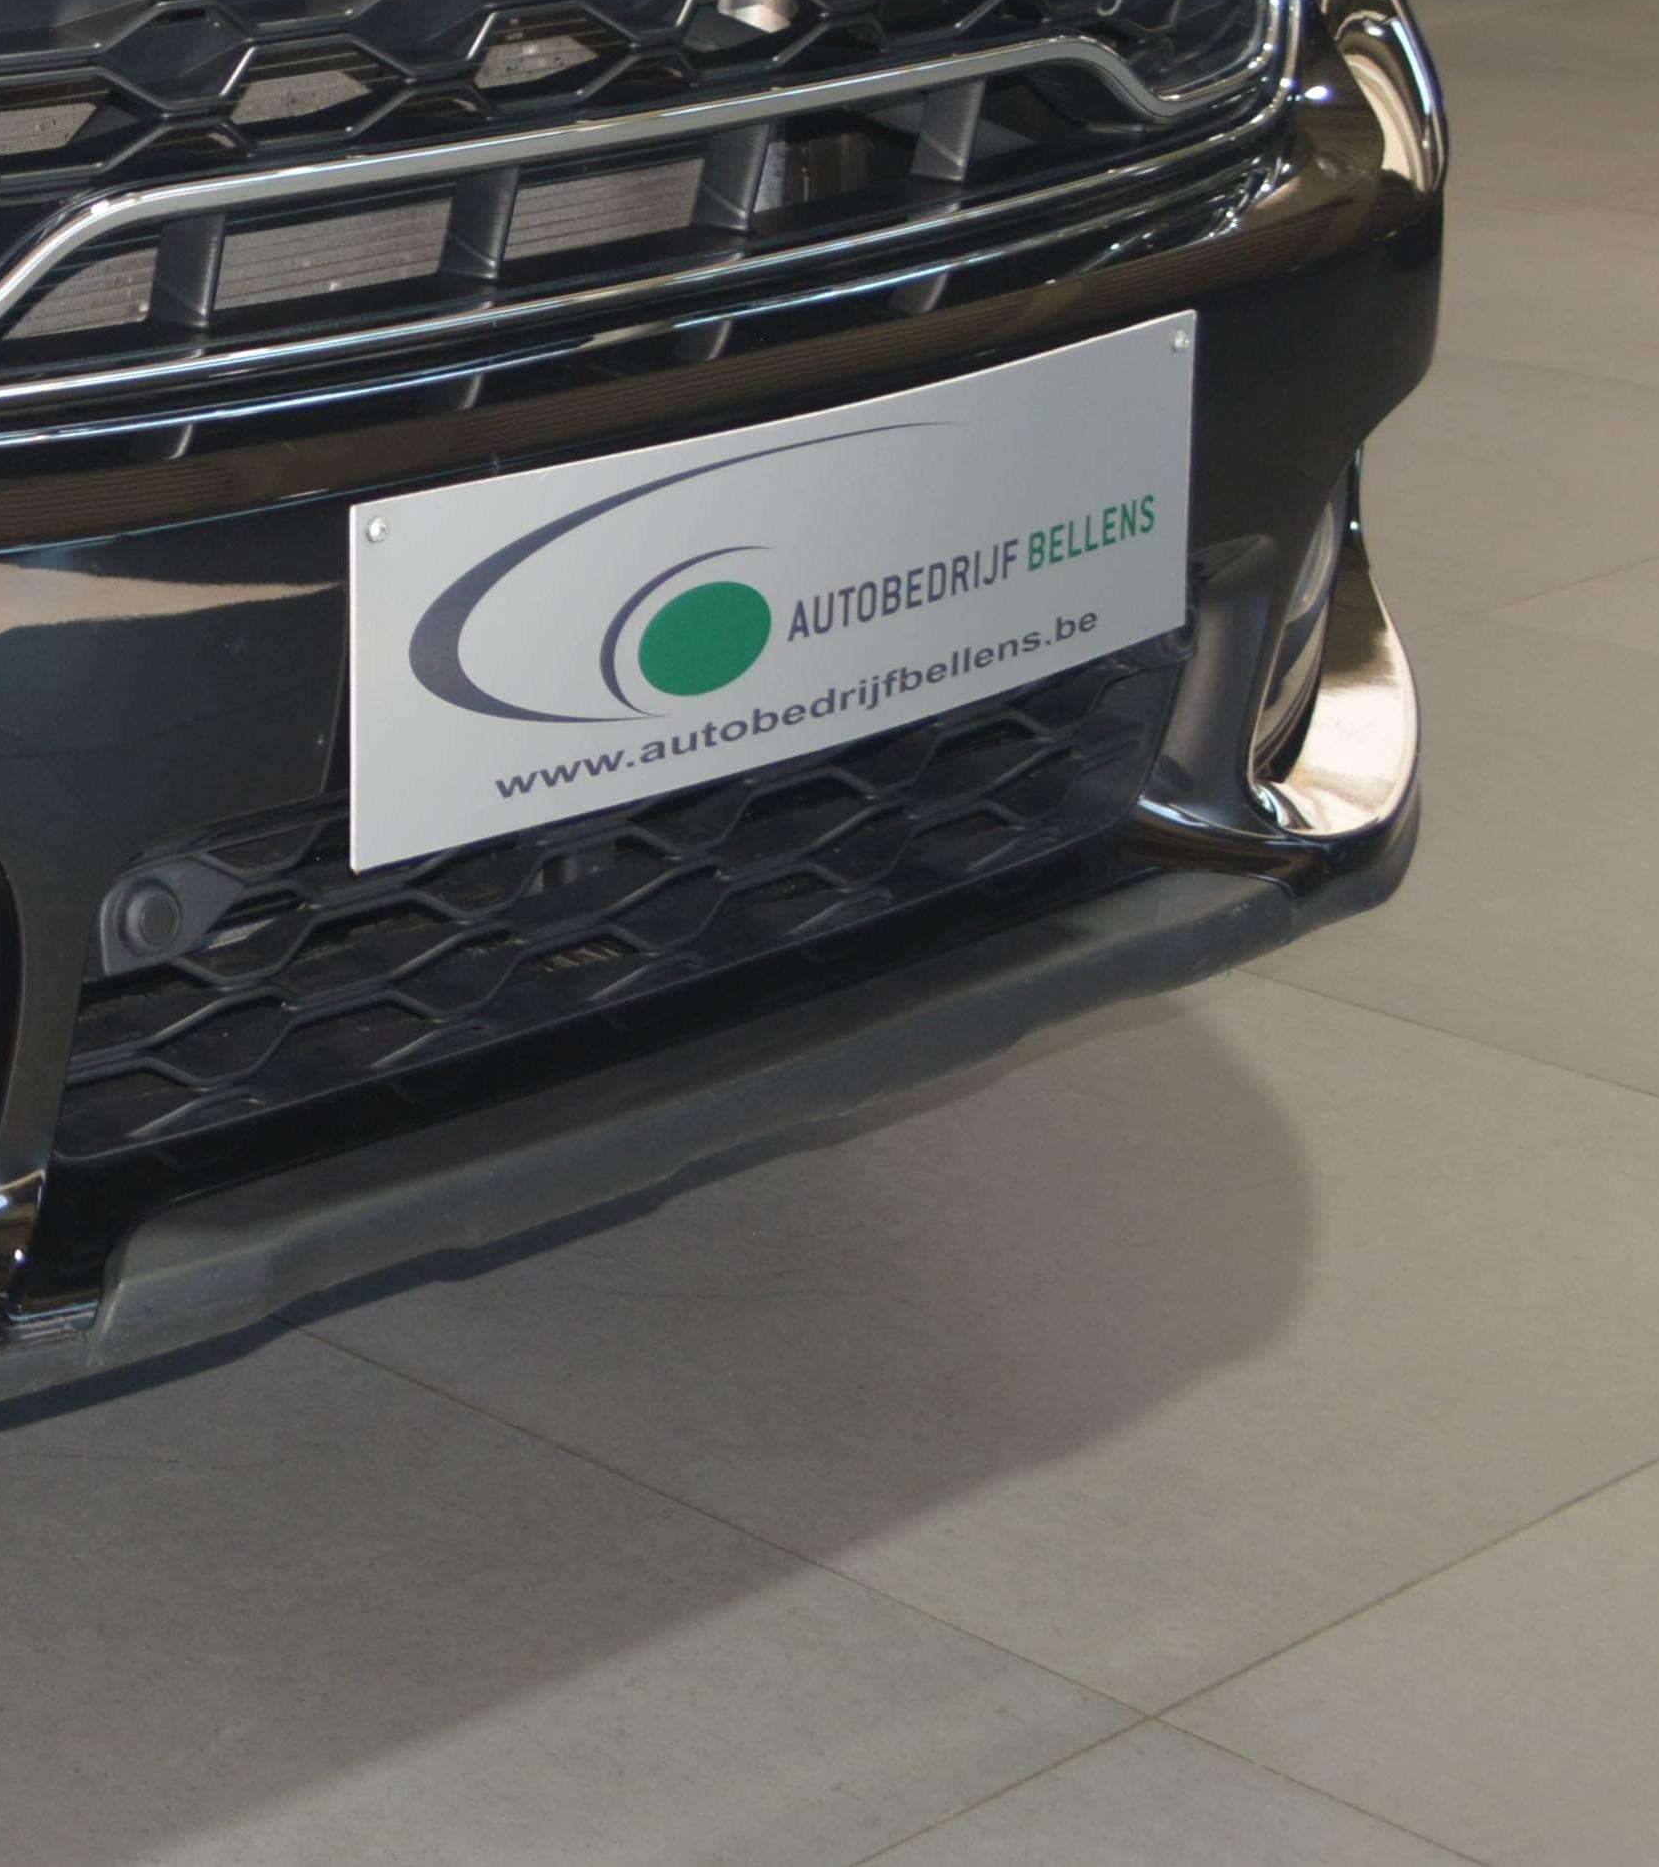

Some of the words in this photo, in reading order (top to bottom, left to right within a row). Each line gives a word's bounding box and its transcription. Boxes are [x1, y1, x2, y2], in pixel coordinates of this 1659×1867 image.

[786, 538, 1020, 643] AUTOBEDRIJF
[1027, 493, 1157, 573] BELLENS
[493, 606, 1100, 801] www.autobedrijfbellens.be
